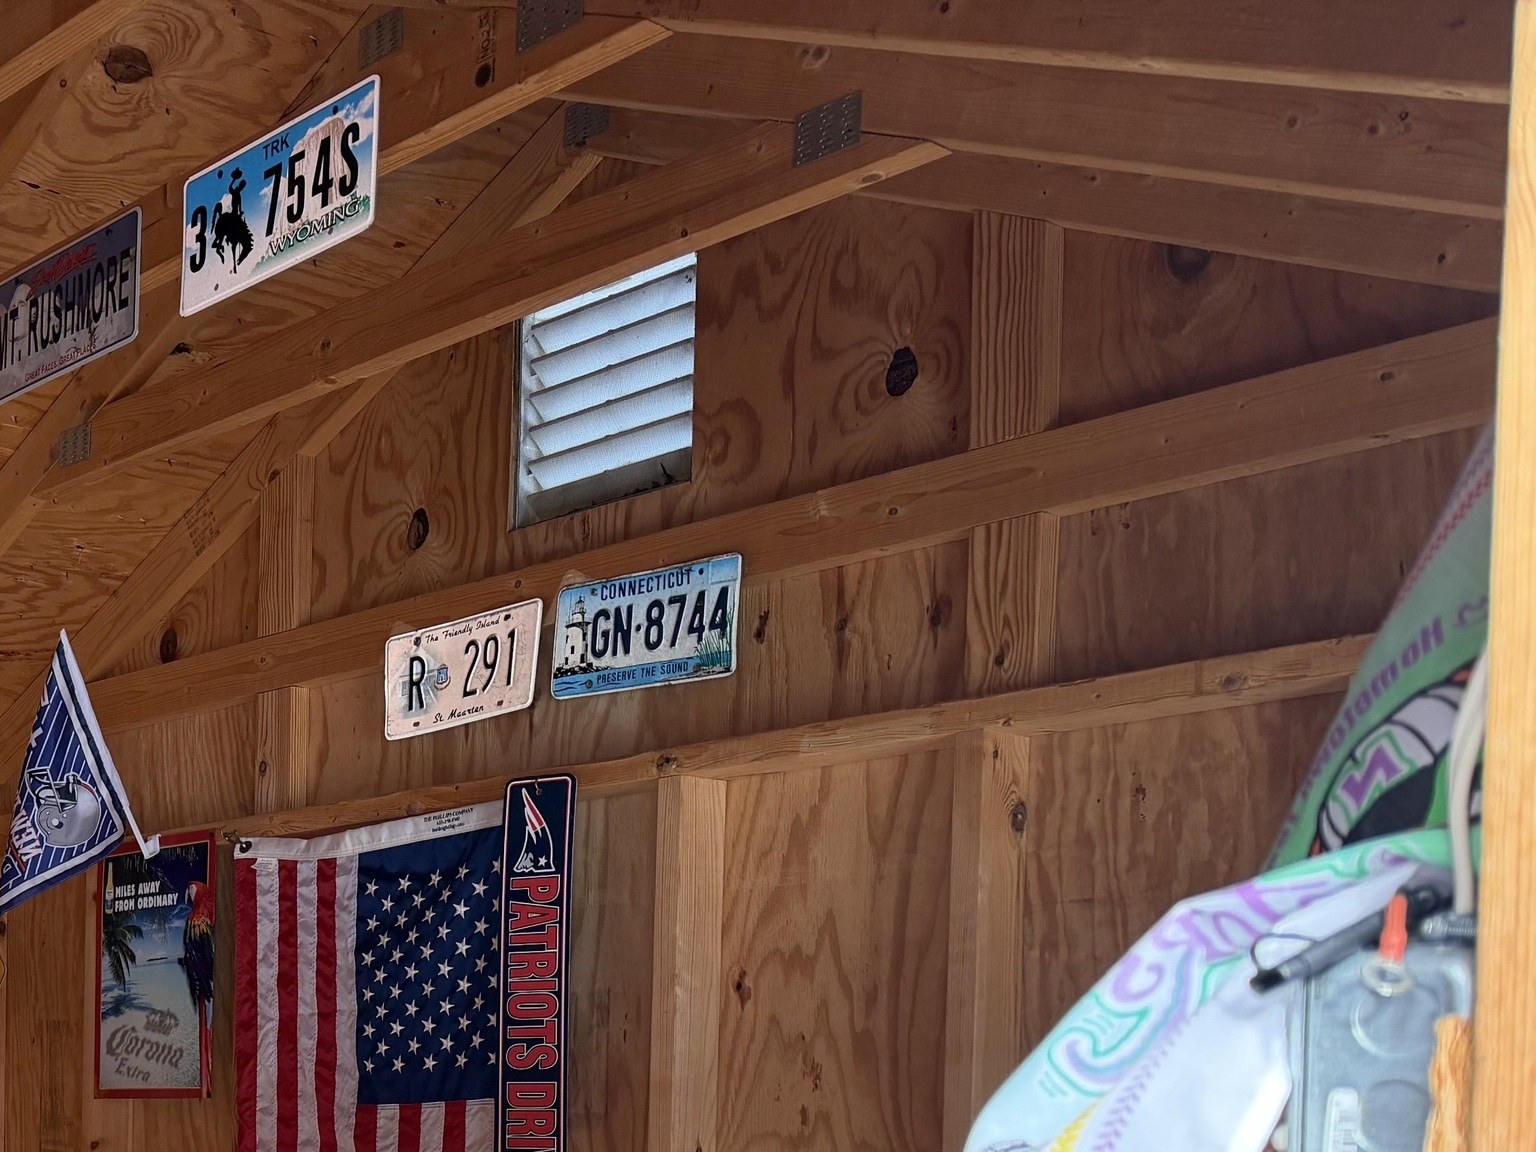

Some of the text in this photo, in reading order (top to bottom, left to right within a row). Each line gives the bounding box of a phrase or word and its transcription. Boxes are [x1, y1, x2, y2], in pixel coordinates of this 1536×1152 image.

[263, 132, 291, 160] TRK
[189, 121, 361, 274] 3 754S
[268, 198, 362, 257] WYOMING
[28, 246, 132, 357] RUSHMORE
[600, 568, 693, 601] CONNECTICUT
[425, 616, 500, 644] The Friendly Island
[408, 627, 516, 711] R 291
[596, 660, 689, 685] PRESERVE THE SOUND
[447, 704, 485, 722] Maarten
[114, 892, 179, 913] FROM ORDINARY
[115, 880, 161, 898] MILES AWAY
[505, 873, 561, 1071] PATRIOTS
[106, 1024, 184, 1070] Corona
[115, 1057, 150, 1083] Extra
